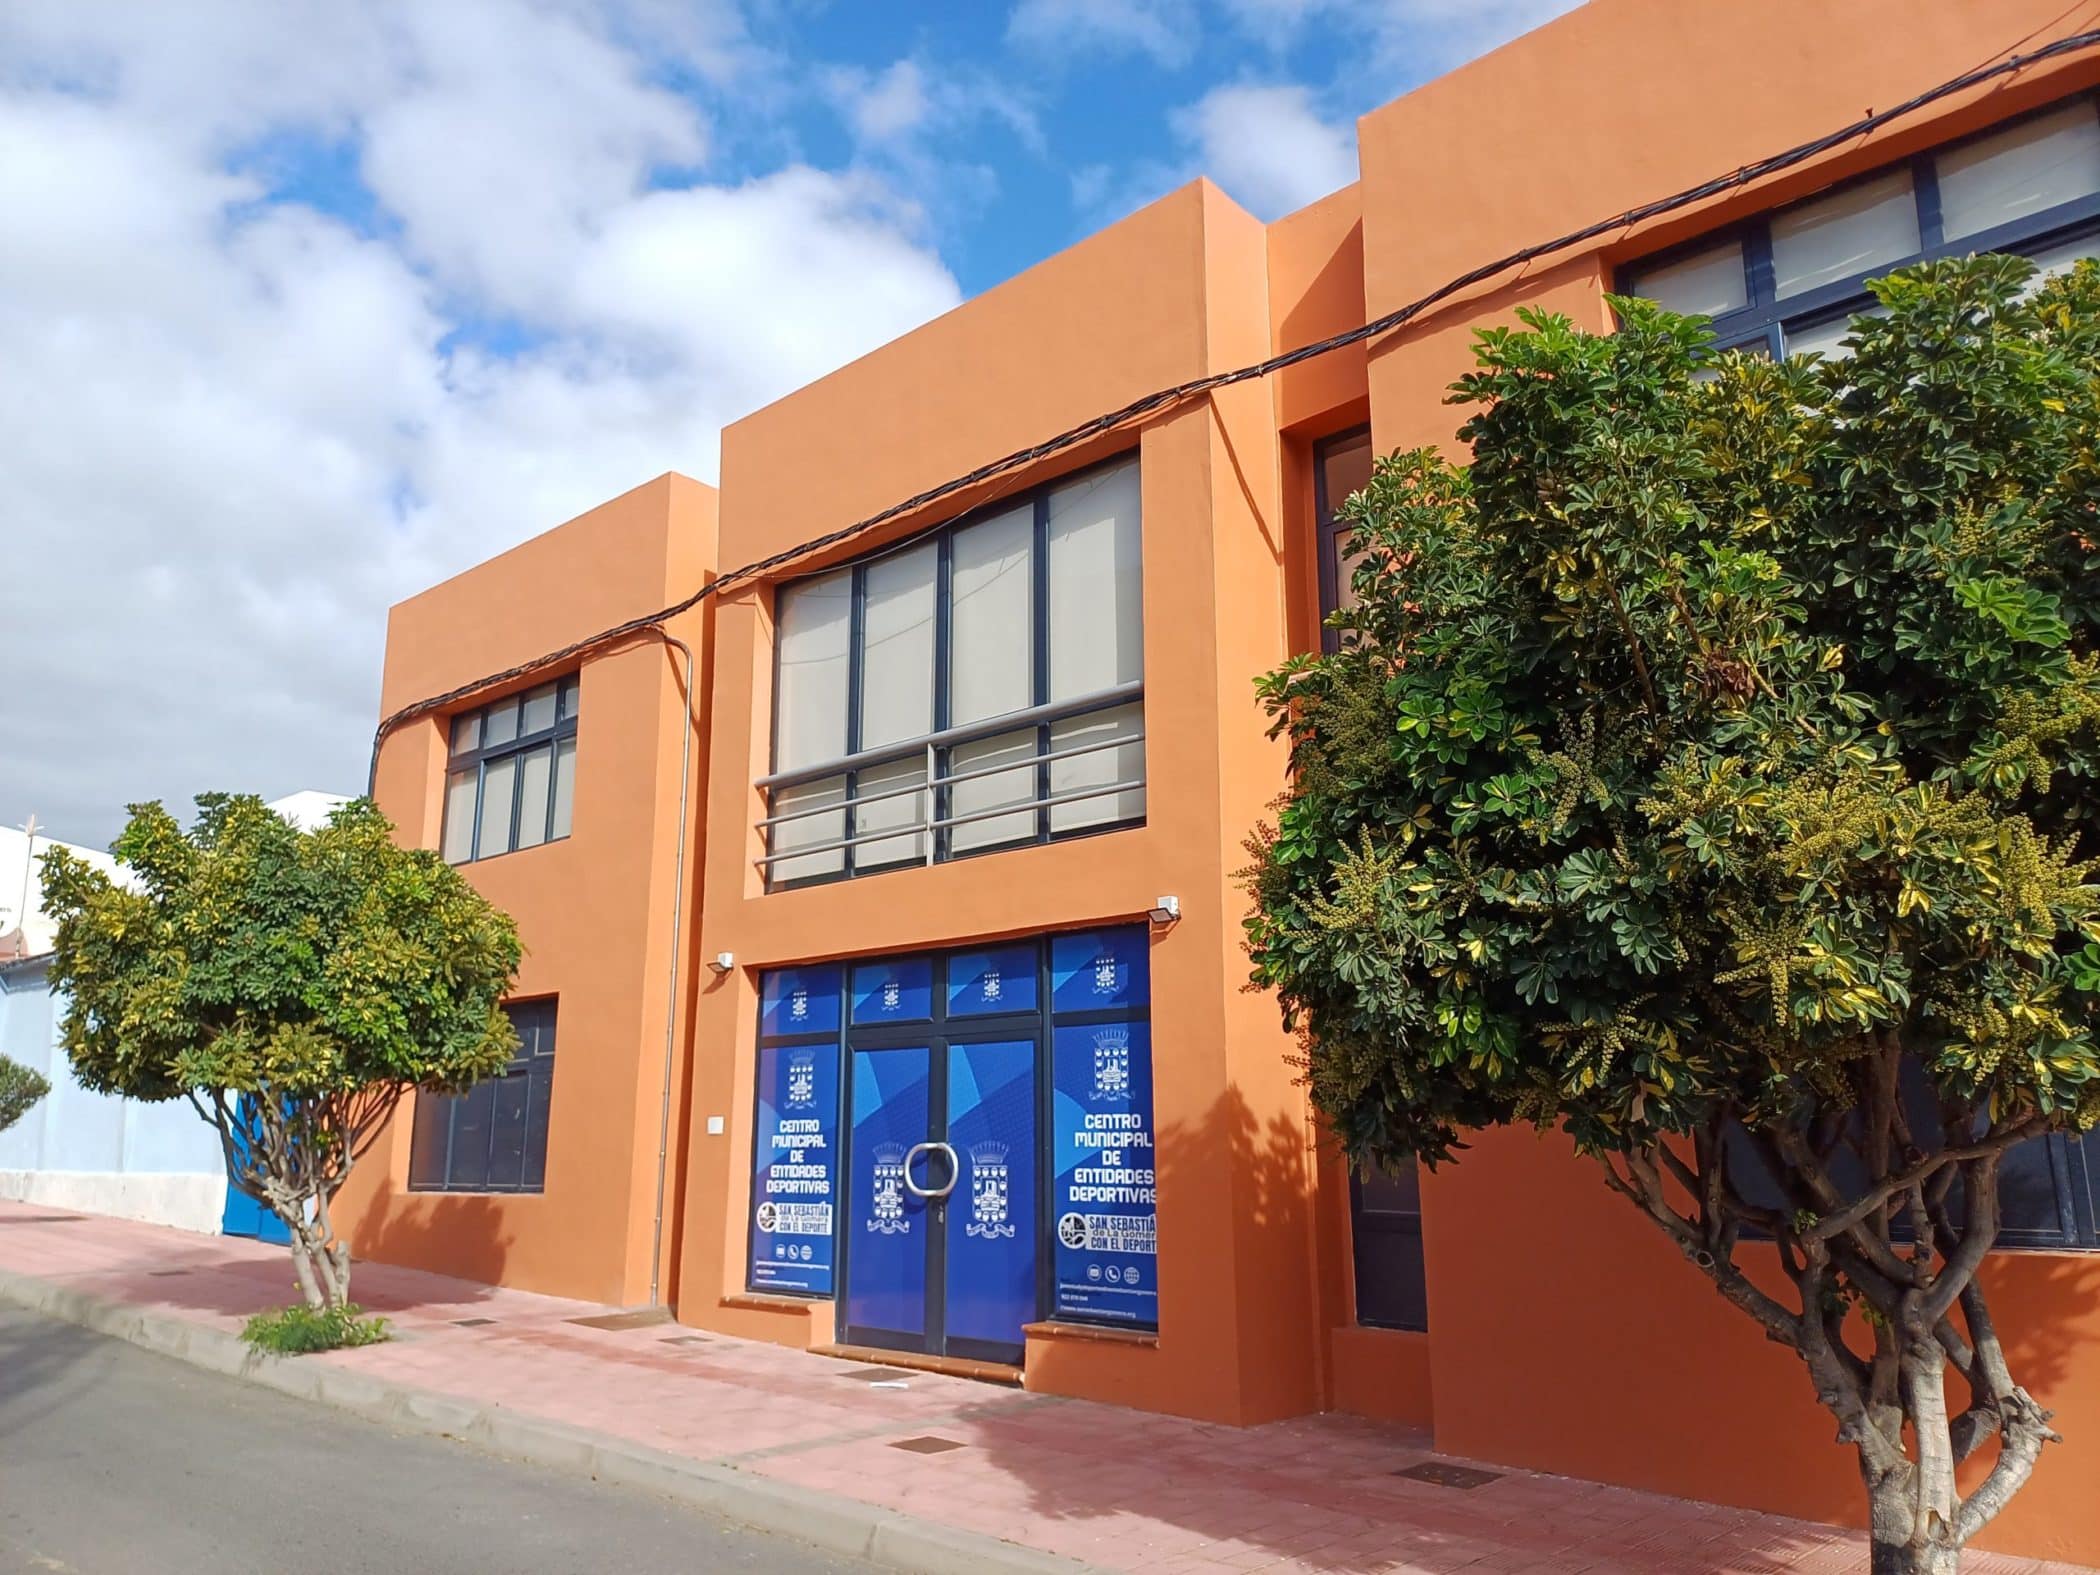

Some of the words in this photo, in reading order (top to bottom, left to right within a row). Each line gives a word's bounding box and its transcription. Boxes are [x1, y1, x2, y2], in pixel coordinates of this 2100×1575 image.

[779, 1119, 820, 1133] CENTRO
[1084, 1113, 1142, 1129] CENTRO
[772, 1134, 827, 1148] MUNICIPAL
[1074, 1131, 1153, 1148] MUNICIPAL
[790, 1149, 805, 1163] DE
[1102, 1149, 1122, 1166] DE
[770, 1164, 827, 1179] ENTIDADES
[1074, 1168, 1154, 1185] ENTIDADES
[766, 1179, 830, 1194] DEPORTIVAS
[1069, 1185, 1157, 1204] DEPORTIVAS
[779, 1204, 791, 1216] SAN
[793, 1202, 829, 1217] SEBASTIÁN
[779, 1222, 791, 1232] CON
[793, 1222, 800, 1232] EL
[801, 1222, 828, 1233] DEPORTE
[1089, 1215, 1107, 1230] SAN
[1110, 1215, 1156, 1232] SEBASTIÁ
[1092, 1229, 1105, 1237] de
[1107, 1228, 1119, 1237] La
[1121, 1230, 1156, 1240] Gomer
[1091, 1236, 1108, 1249] CON
[1111, 1237, 1120, 1250] EL
[1122, 1238, 1156, 1252] DEPORT
